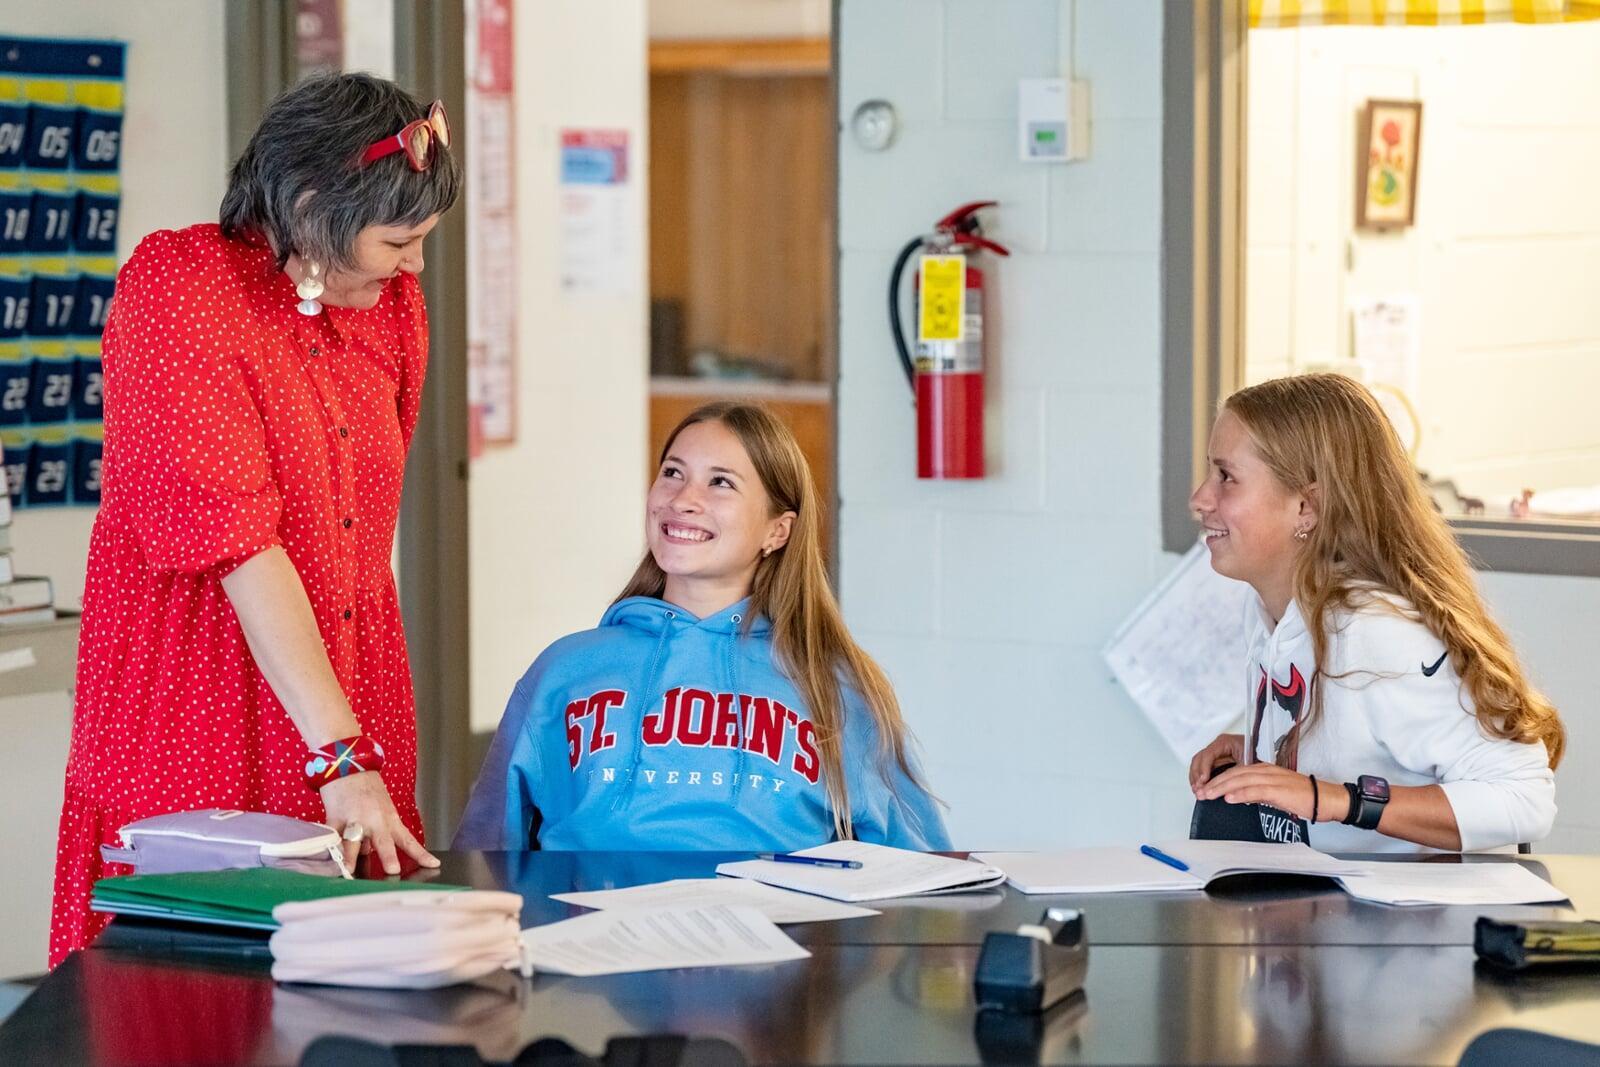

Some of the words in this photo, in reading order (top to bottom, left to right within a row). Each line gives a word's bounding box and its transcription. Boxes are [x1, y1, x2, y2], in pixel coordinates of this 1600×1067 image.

[38, 126, 70, 158] 05
[86, 130, 120, 162] 06
[4, 208, 30, 240] 10
[45, 209, 70, 240] 11
[87, 207, 117, 240] 12
[4, 296, 29, 329] 16
[46, 294, 74, 327] 17
[84, 372, 103, 405] 2
[85, 459, 102, 491] 3
[564, 689, 628, 772] ST.
[642, 686, 821, 785] JOHN'S
[588, 767, 785, 792] NVERSITY
